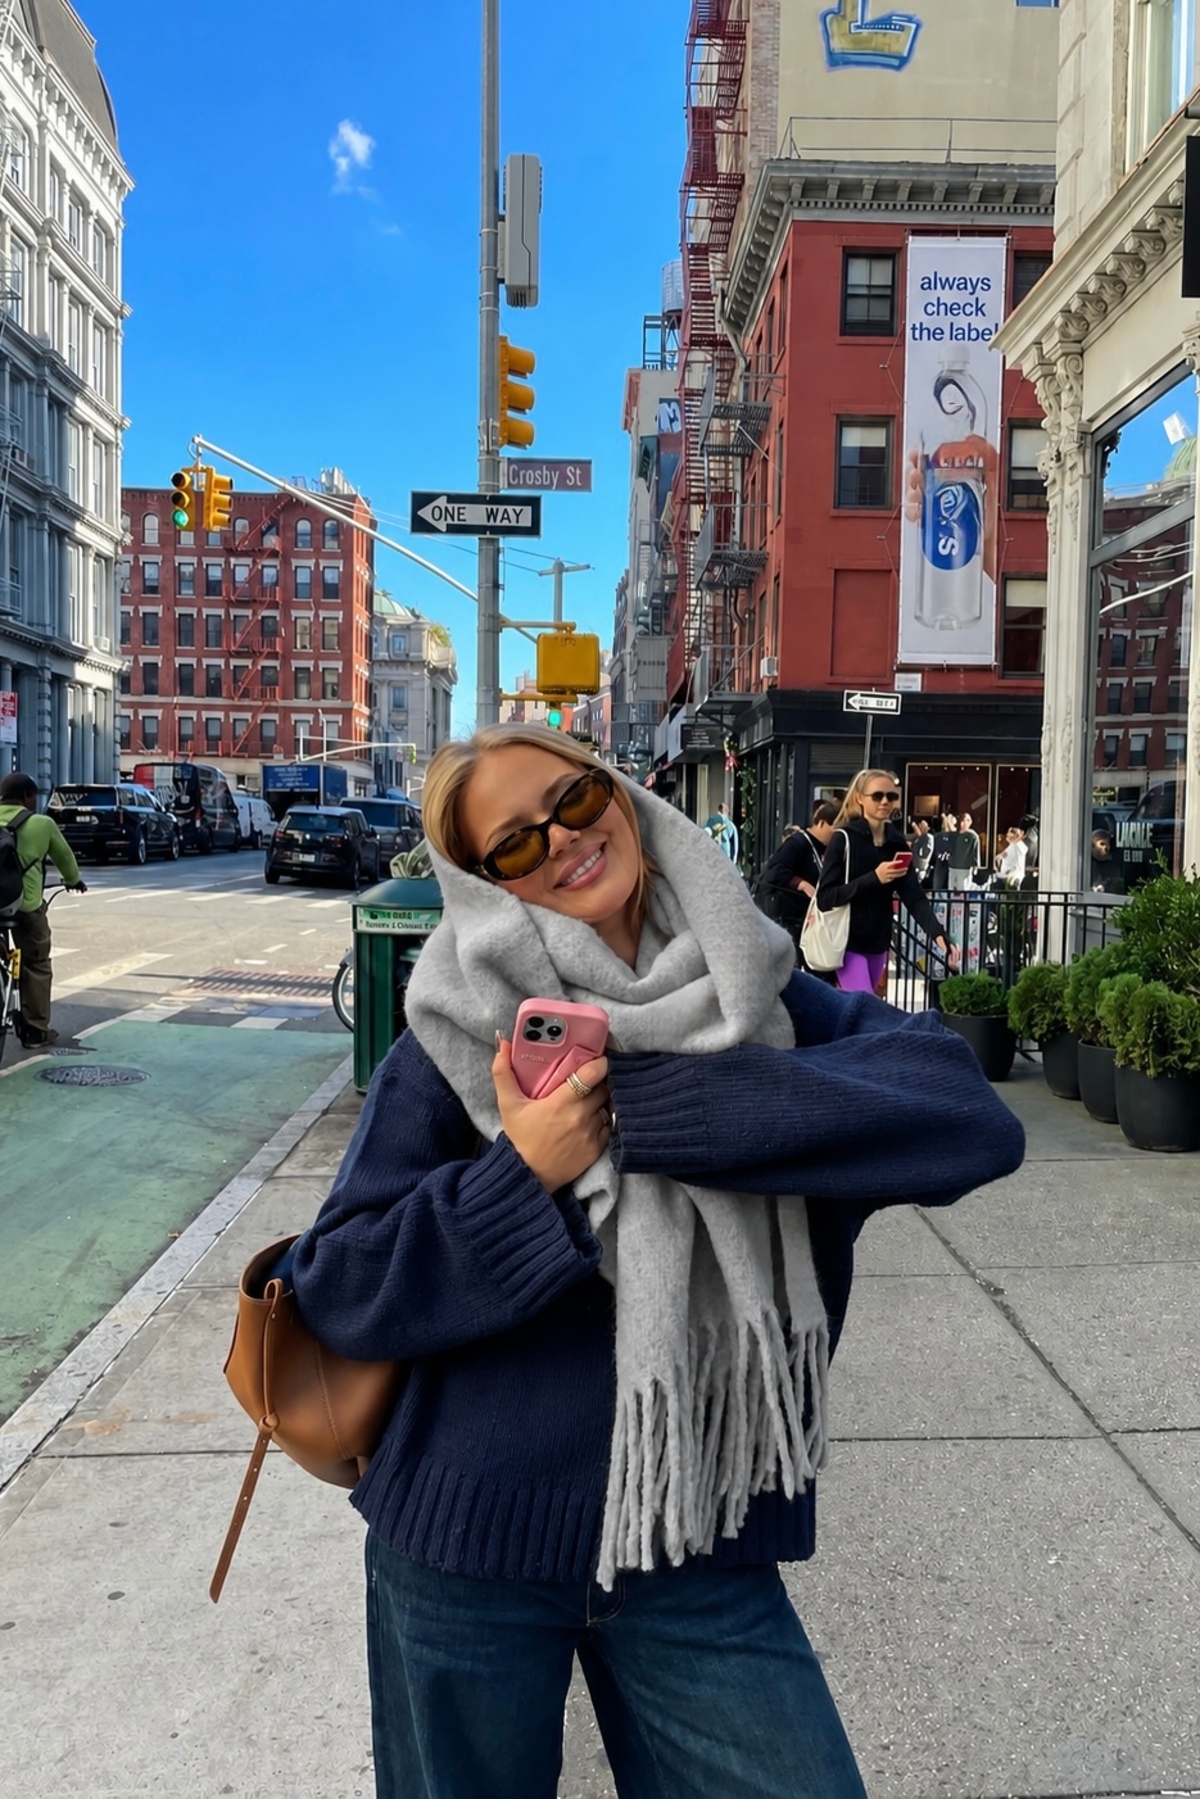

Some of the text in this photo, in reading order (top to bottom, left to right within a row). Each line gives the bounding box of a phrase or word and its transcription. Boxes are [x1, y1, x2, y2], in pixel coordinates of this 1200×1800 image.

[920, 271, 992, 295] always
[923, 296, 986, 317] check
[910, 321, 945, 341] the
[509, 464, 582, 489] Crosby St
[431, 505, 524, 524] ONE WAY
